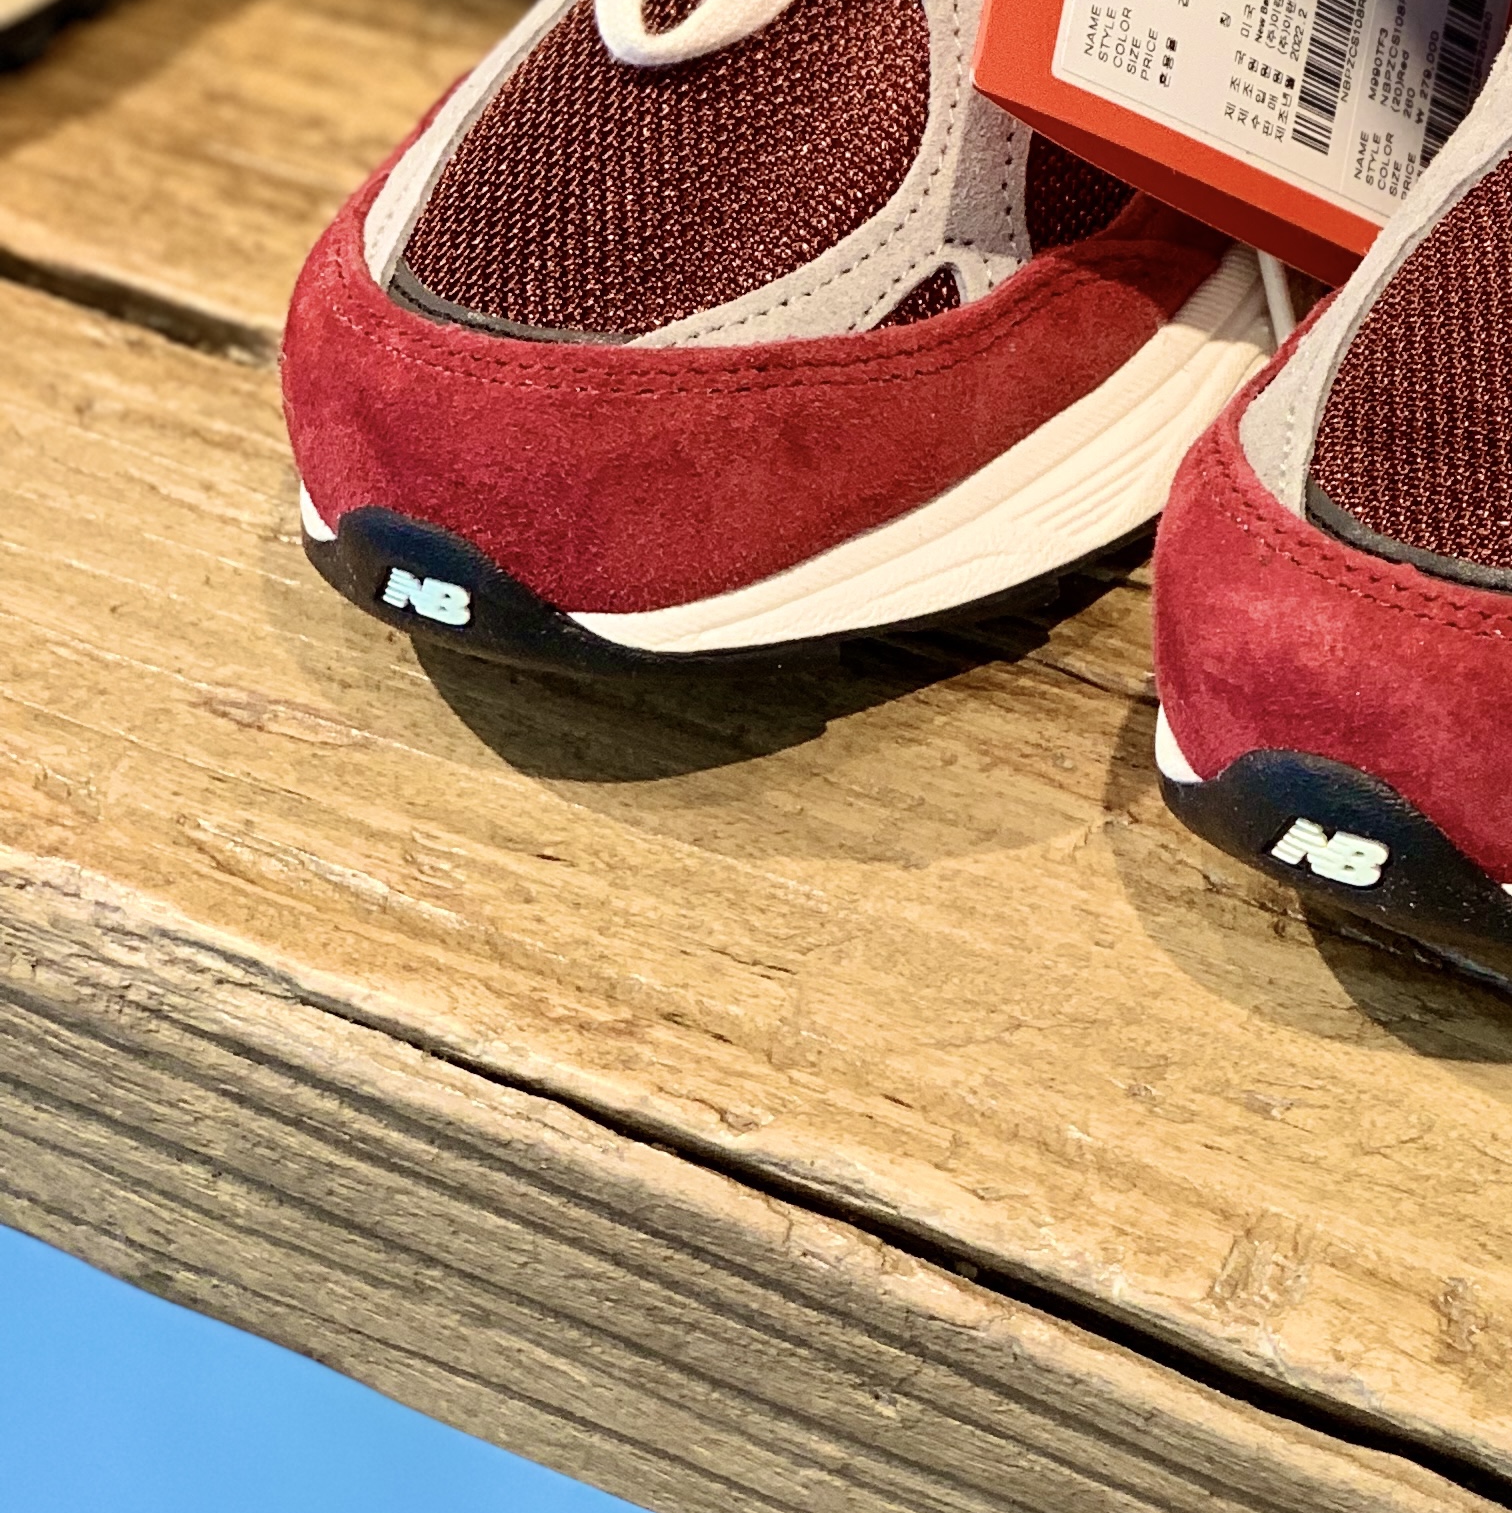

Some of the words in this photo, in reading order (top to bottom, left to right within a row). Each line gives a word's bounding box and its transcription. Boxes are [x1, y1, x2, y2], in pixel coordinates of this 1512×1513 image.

[1083, 4, 1101, 56] NAME
[1097, 6, 1116, 62] STYLE
[1112, 6, 1132, 68] COLOR
[1126, 36, 1141, 74] SIZE
[1139, 27, 1158, 81] PRICE
[1253, 16, 1266, 43] New
[1289, 7, 1308, 62] 2022.2
[1353, 130, 1369, 180] NAME
[1365, 132, 1381, 186] STYLE
[1377, 131, 1394, 190] COLOR
[1388, 159, 1402, 197] SIZE
[382, 566, 471, 626] NB
[1270, 816, 1390, 887] NB
